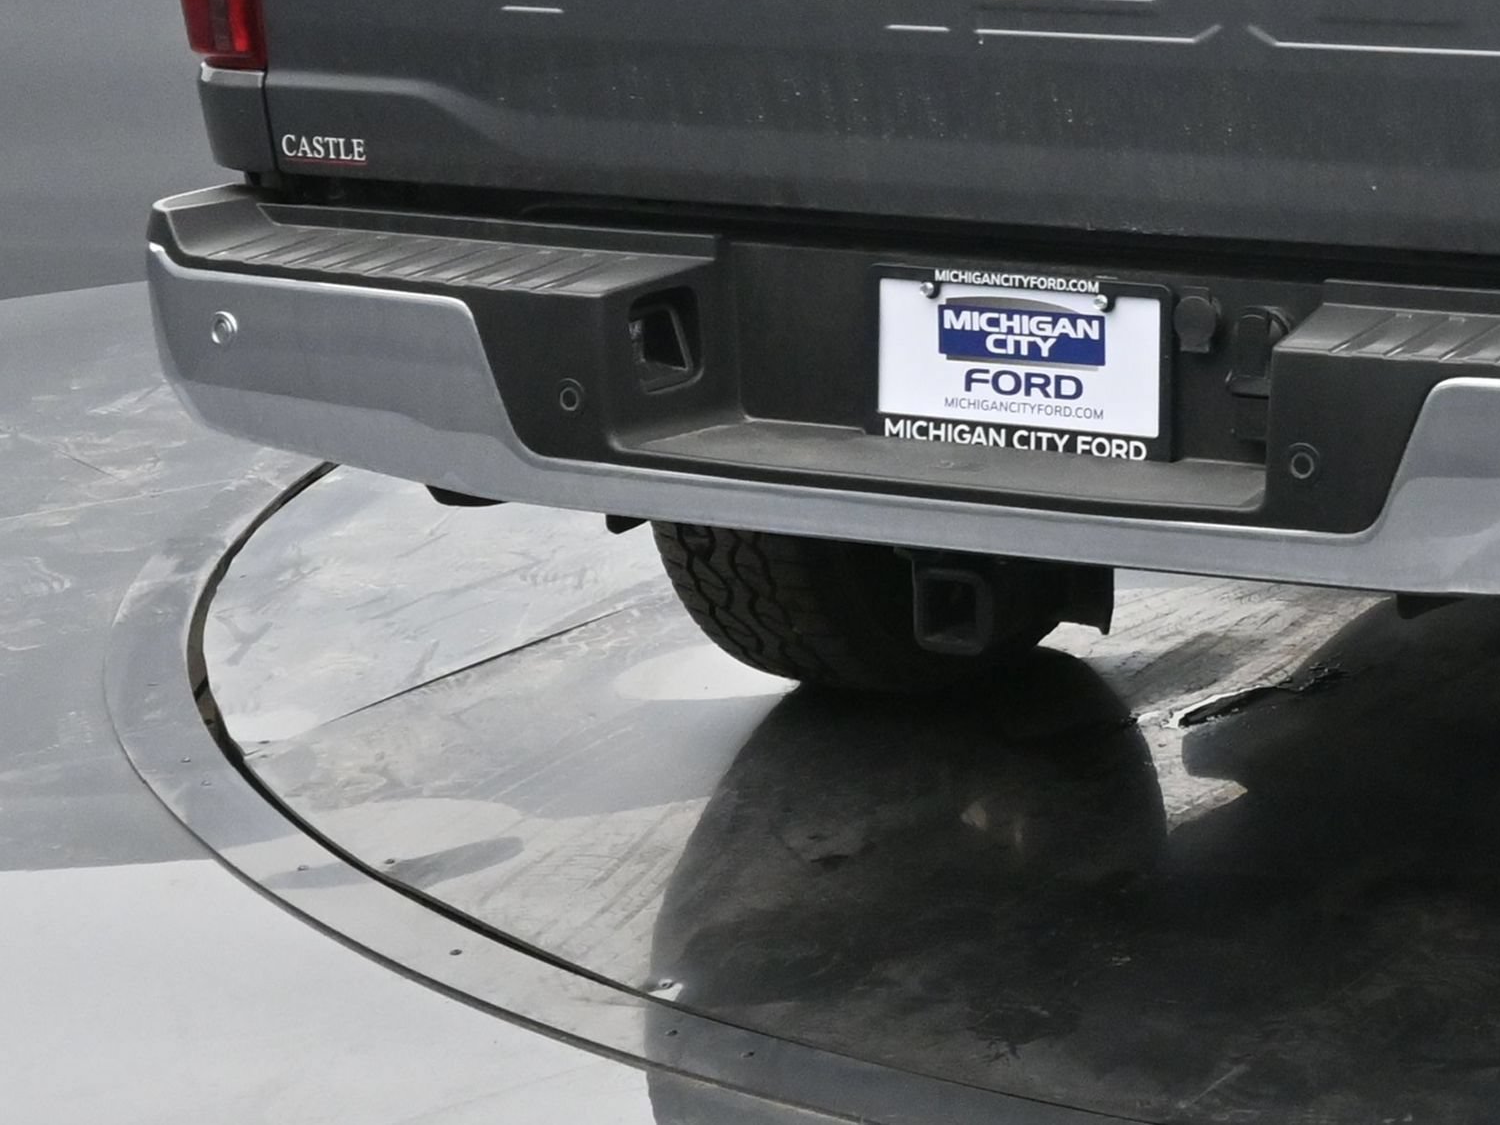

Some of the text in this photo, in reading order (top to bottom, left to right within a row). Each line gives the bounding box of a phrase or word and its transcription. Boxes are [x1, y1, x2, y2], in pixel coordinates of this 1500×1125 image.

[281, 134, 367, 161] CASTLE
[935, 269, 1099, 293] MICHIGANCITYFORD.COM
[943, 309, 1099, 340] MICHIGAN
[985, 335, 1057, 357] CITY
[964, 368, 1083, 400] FORD
[944, 397, 1104, 420] MICHIGANCITYFORD.COM
[884, 418, 1147, 461] MICHIGAN CITY FORD
